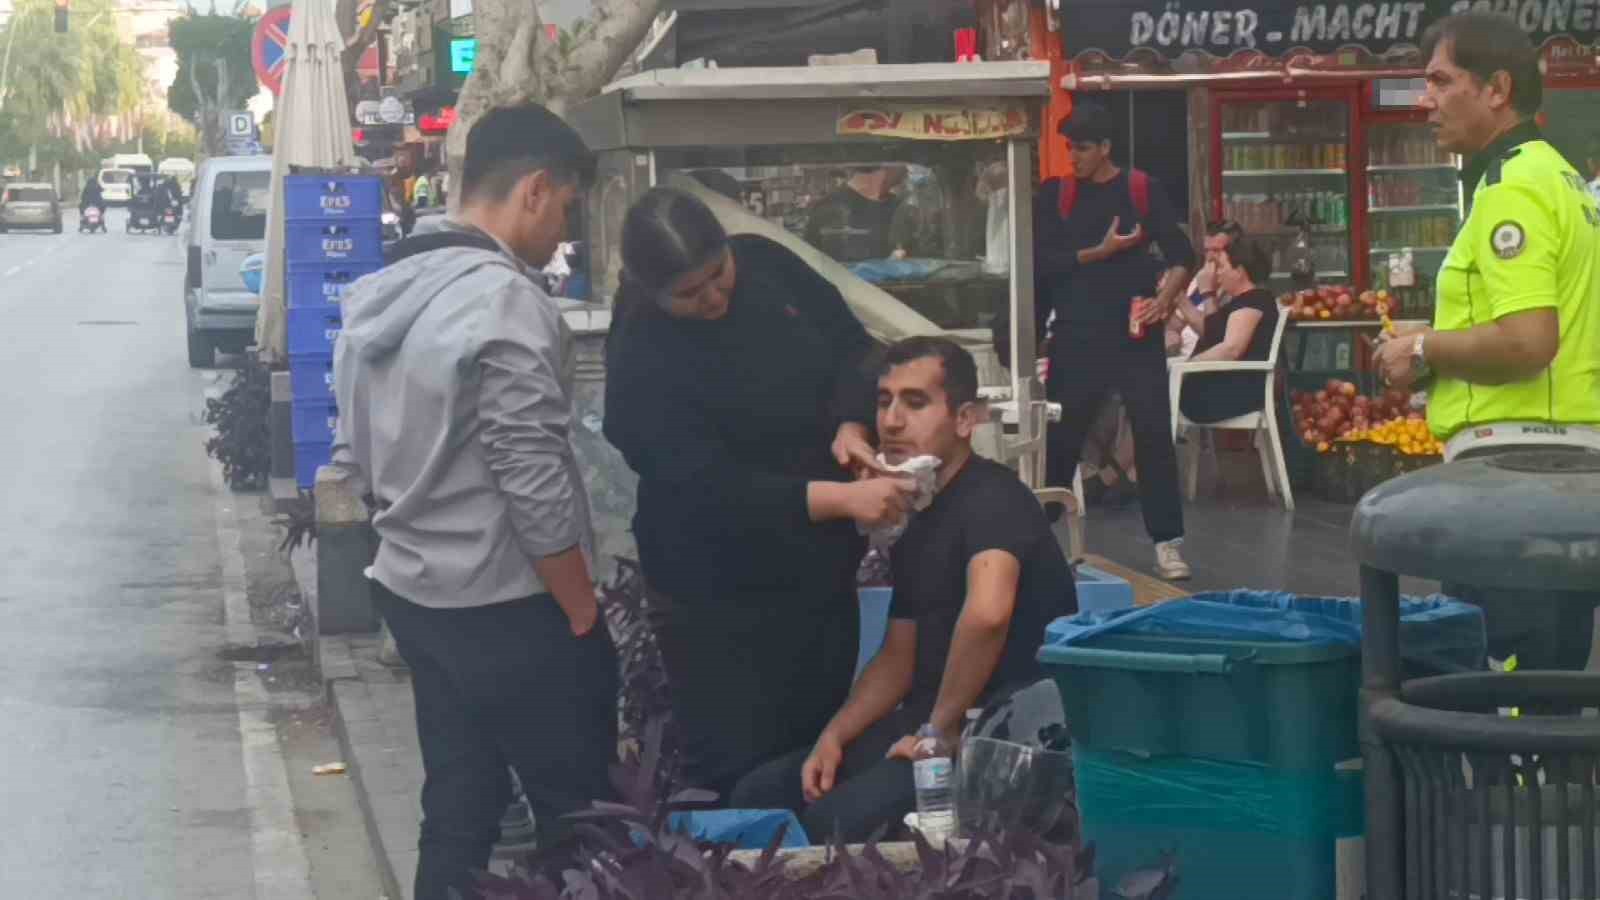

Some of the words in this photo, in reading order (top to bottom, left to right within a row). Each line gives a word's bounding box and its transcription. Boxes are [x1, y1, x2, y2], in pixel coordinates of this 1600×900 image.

[1130, 1, 1258, 48] DÖNER
[1291, 3, 1425, 41] MACHT
[235, 117, 247, 132] D
